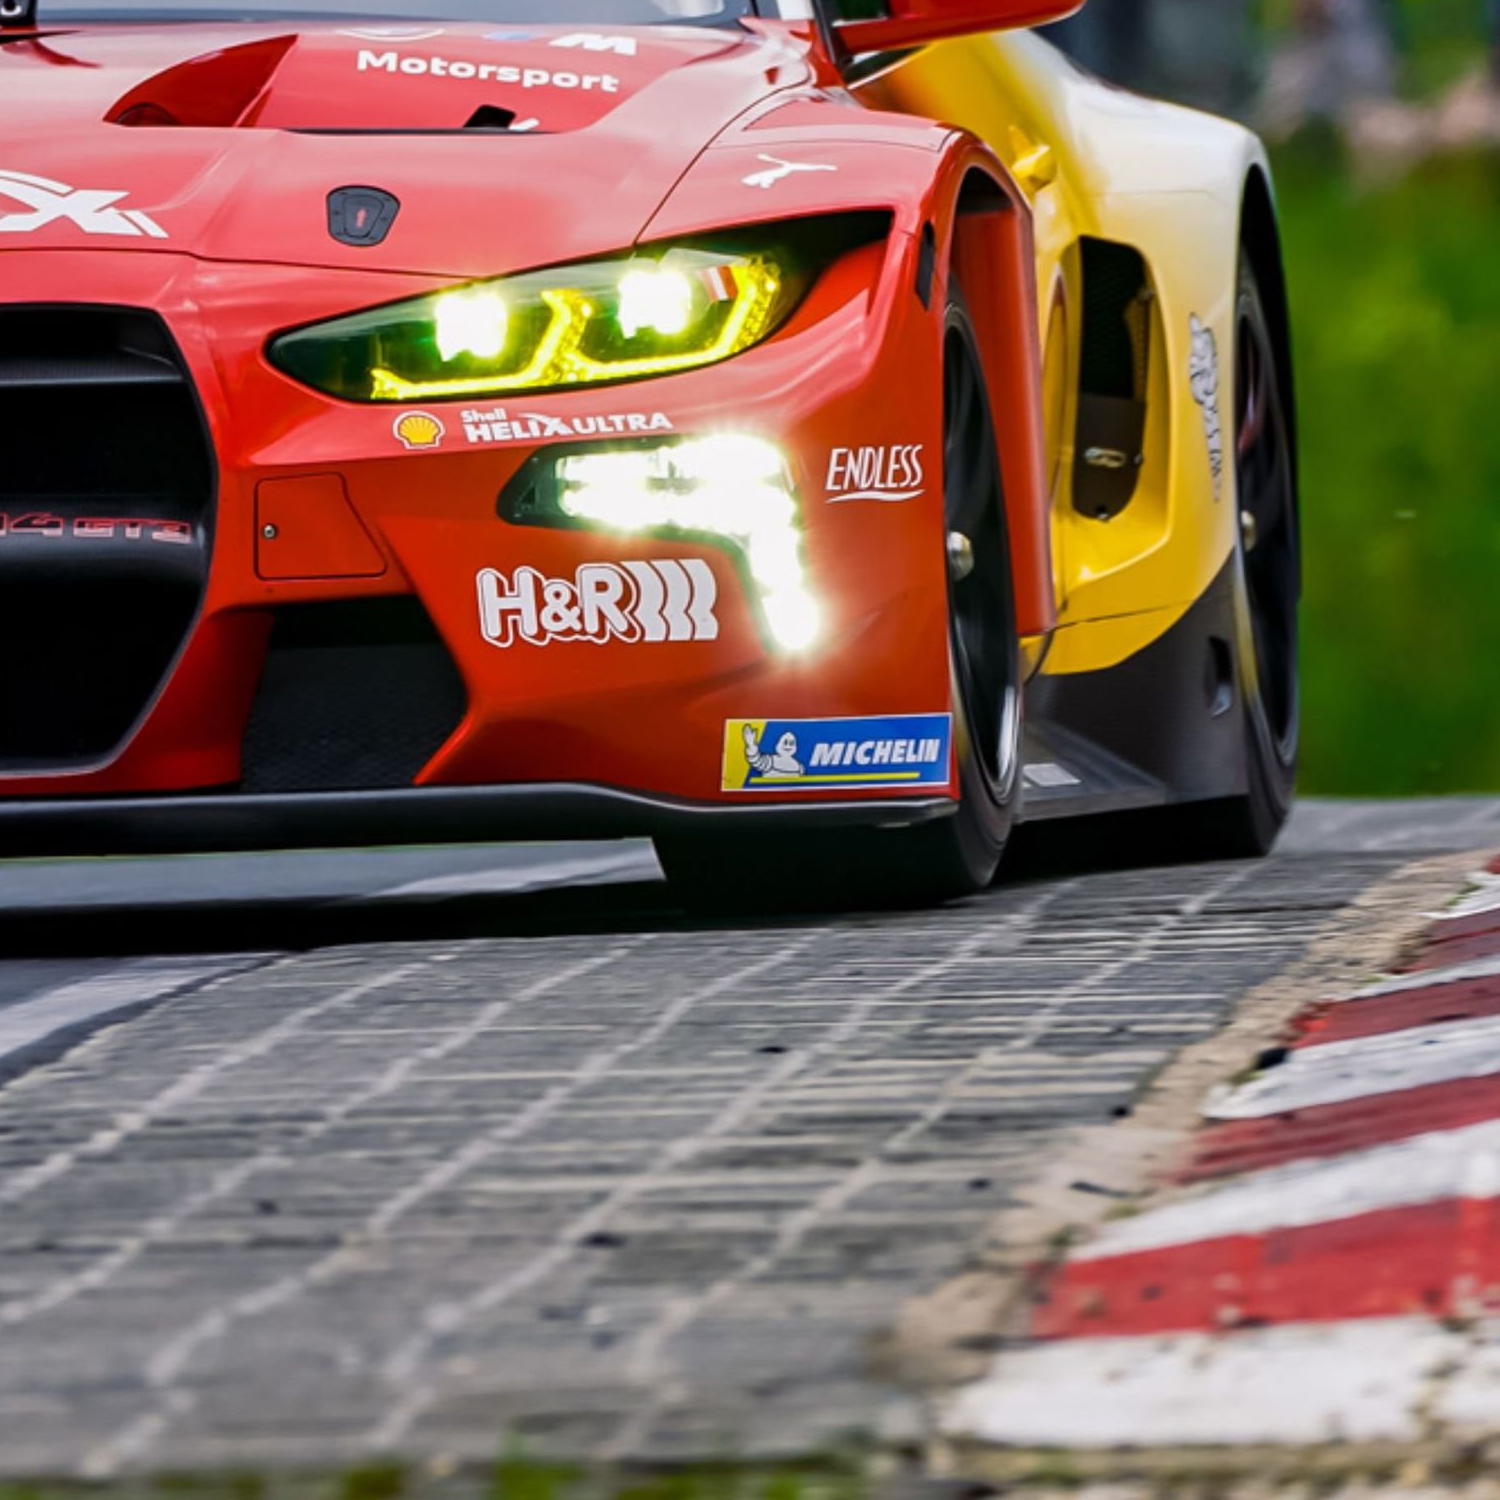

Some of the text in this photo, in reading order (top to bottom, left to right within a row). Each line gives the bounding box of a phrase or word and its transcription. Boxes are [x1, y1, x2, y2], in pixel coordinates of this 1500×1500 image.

[357, 49, 620, 93] Motorsport
[461, 408, 507, 423] Shell
[463, 411, 674, 443] HELIX ULTRA
[825, 444, 924, 492] ENDLESS
[476, 562, 642, 648] H&R
[810, 737, 941, 767] MICHELIN
